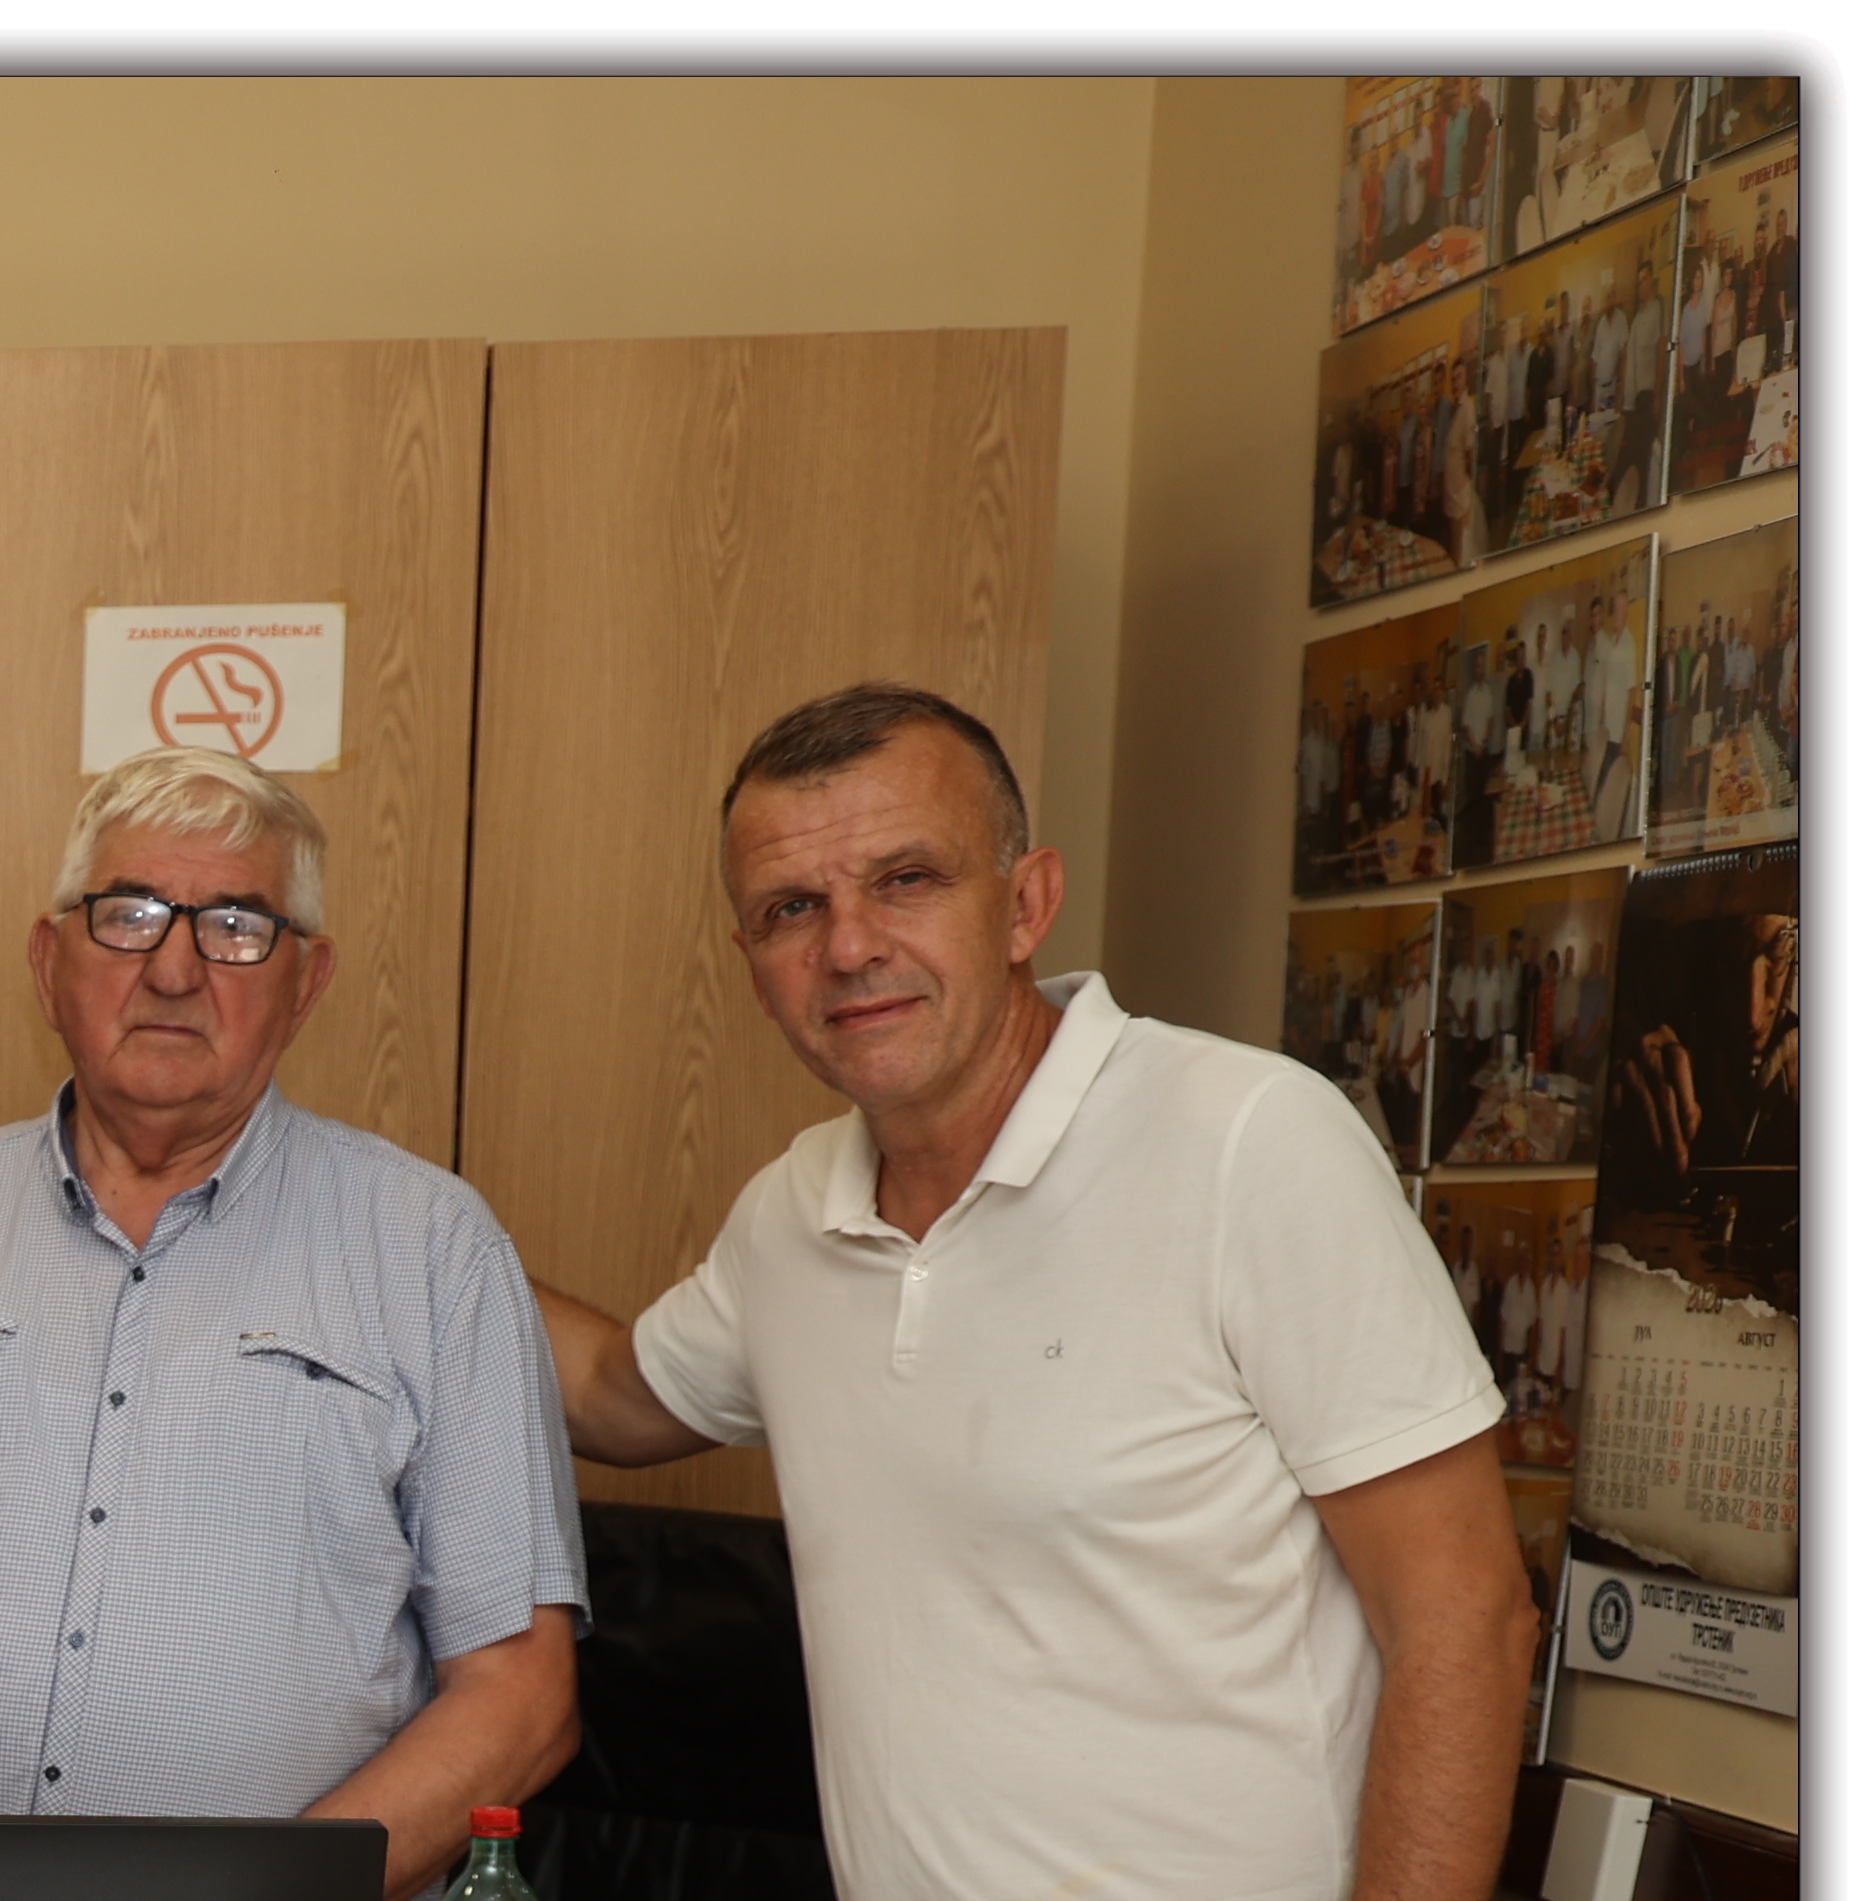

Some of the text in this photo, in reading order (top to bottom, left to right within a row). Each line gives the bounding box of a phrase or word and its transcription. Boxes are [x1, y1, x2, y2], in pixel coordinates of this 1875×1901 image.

[127, 623, 324, 640] ZABRANJENO PUŠENJE
[1046, 1338, 1064, 1359] ck
[1738, 1331, 1777, 1349] АВГУСТ
[1714, 1405, 1720, 1421] 4
[1729, 1405, 1735, 1423] 5
[1744, 1407, 1751, 1424] 6
[1759, 1408, 1767, 1426] 7
[1776, 1410, 1783, 1427] 8
[1724, 1436, 1735, 1453] 12
[1739, 1438, 1749, 1455] 13
[1754, 1439, 1765, 1457] 14
[1771, 1441, 1782, 1458] 15
[1720, 1467, 1732, 1484] 19
[1767, 1472, 1780, 1488] 22
[1784, 1473, 1797, 1490] 23
[1748, 1501, 1761, 1518] 28
[1764, 1503, 1778, 1520] 29
[1781, 1505, 1796, 1522] 30
